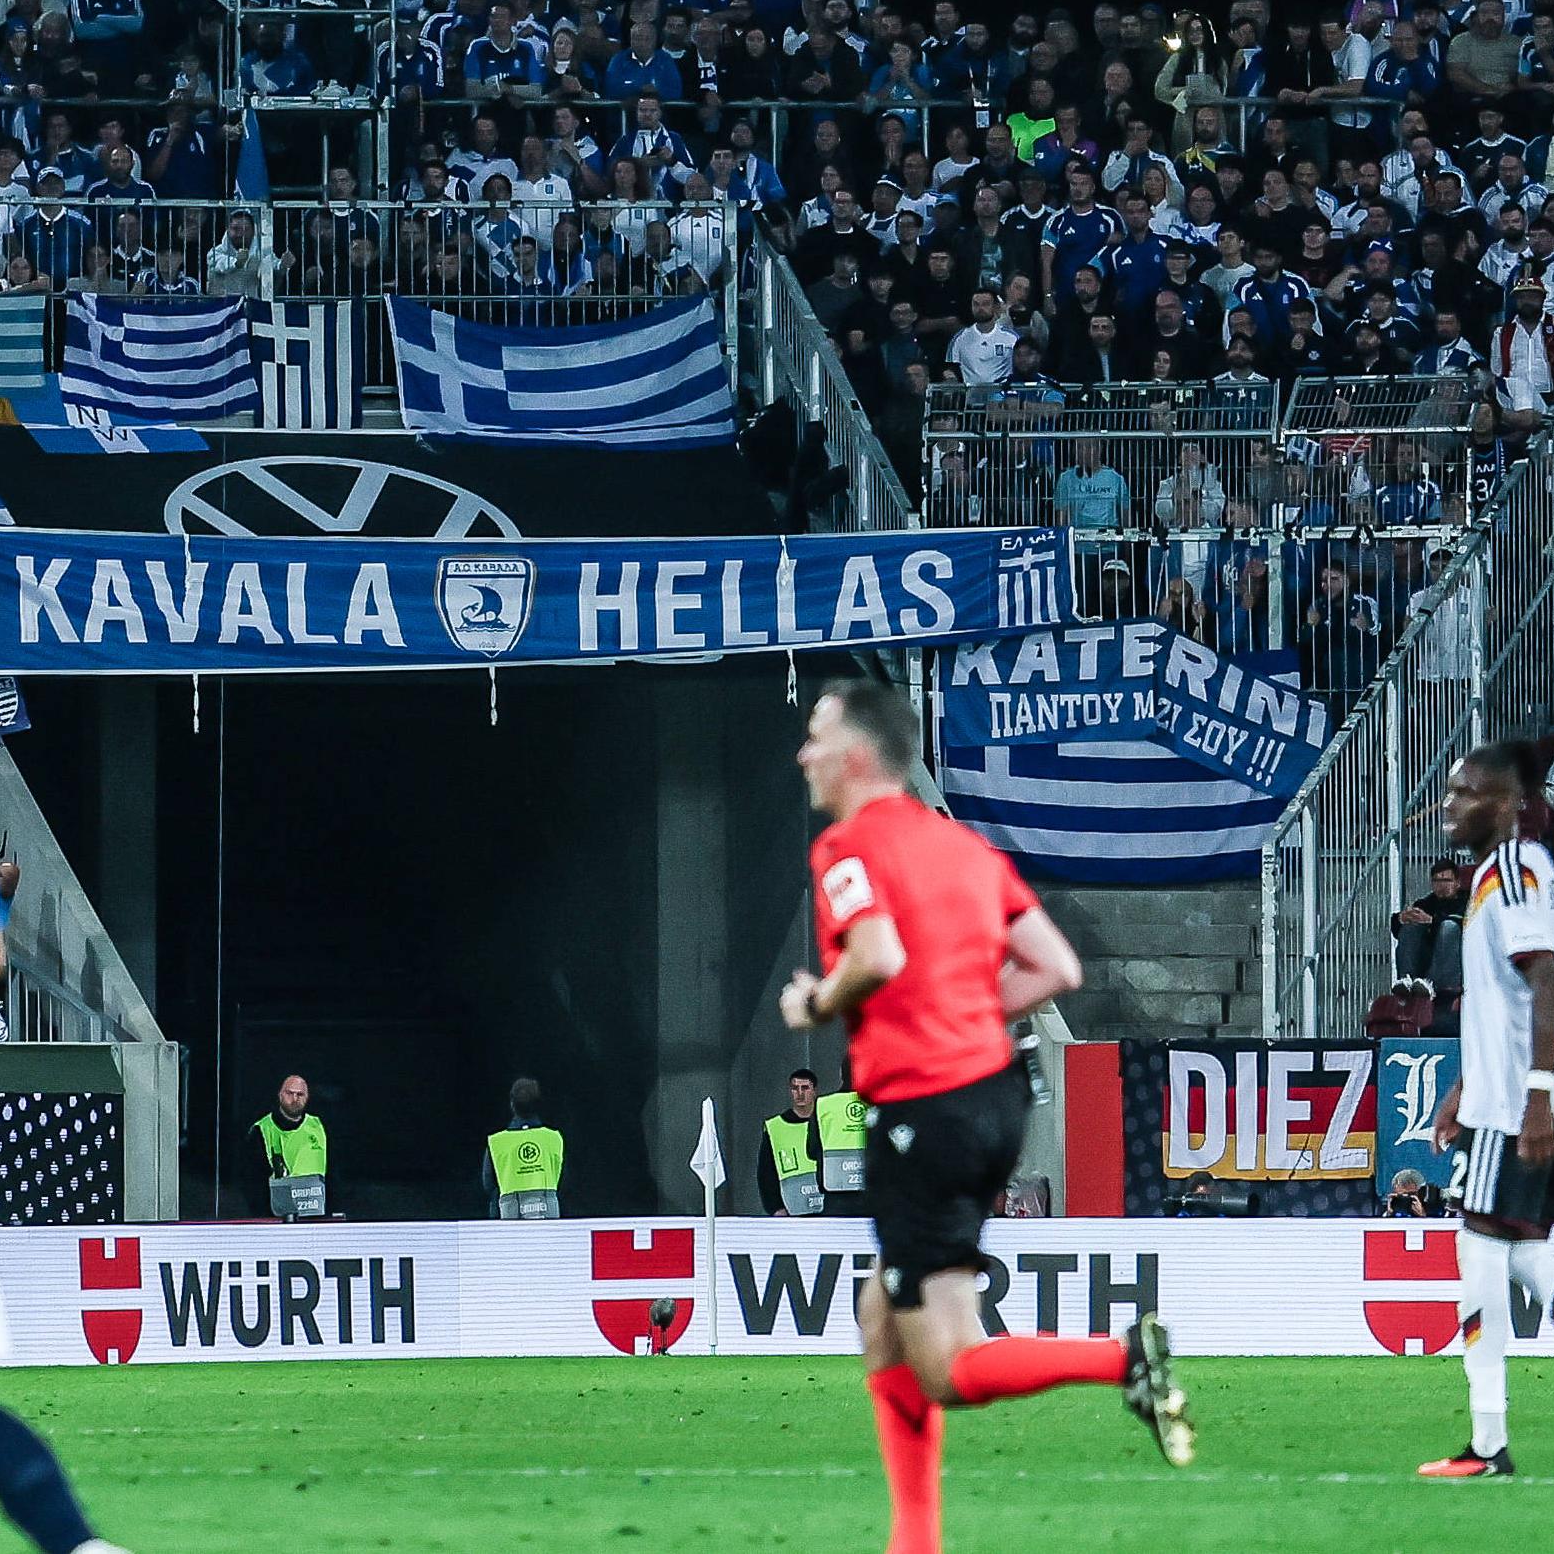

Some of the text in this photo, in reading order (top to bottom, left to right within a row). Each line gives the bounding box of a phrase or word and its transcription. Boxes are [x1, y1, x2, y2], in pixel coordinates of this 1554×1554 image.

[15, 549, 958, 652] KAVALA HELLAS
[988, 692, 1124, 739] ΠΑΝΤΟΥ
[1183, 711, 1249, 766] ΣΟΥ
[1166, 1050, 1373, 1172] DIEZ
[1449, 1150, 1468, 1199] 2
[160, 1256, 416, 1348] WÜRTH
